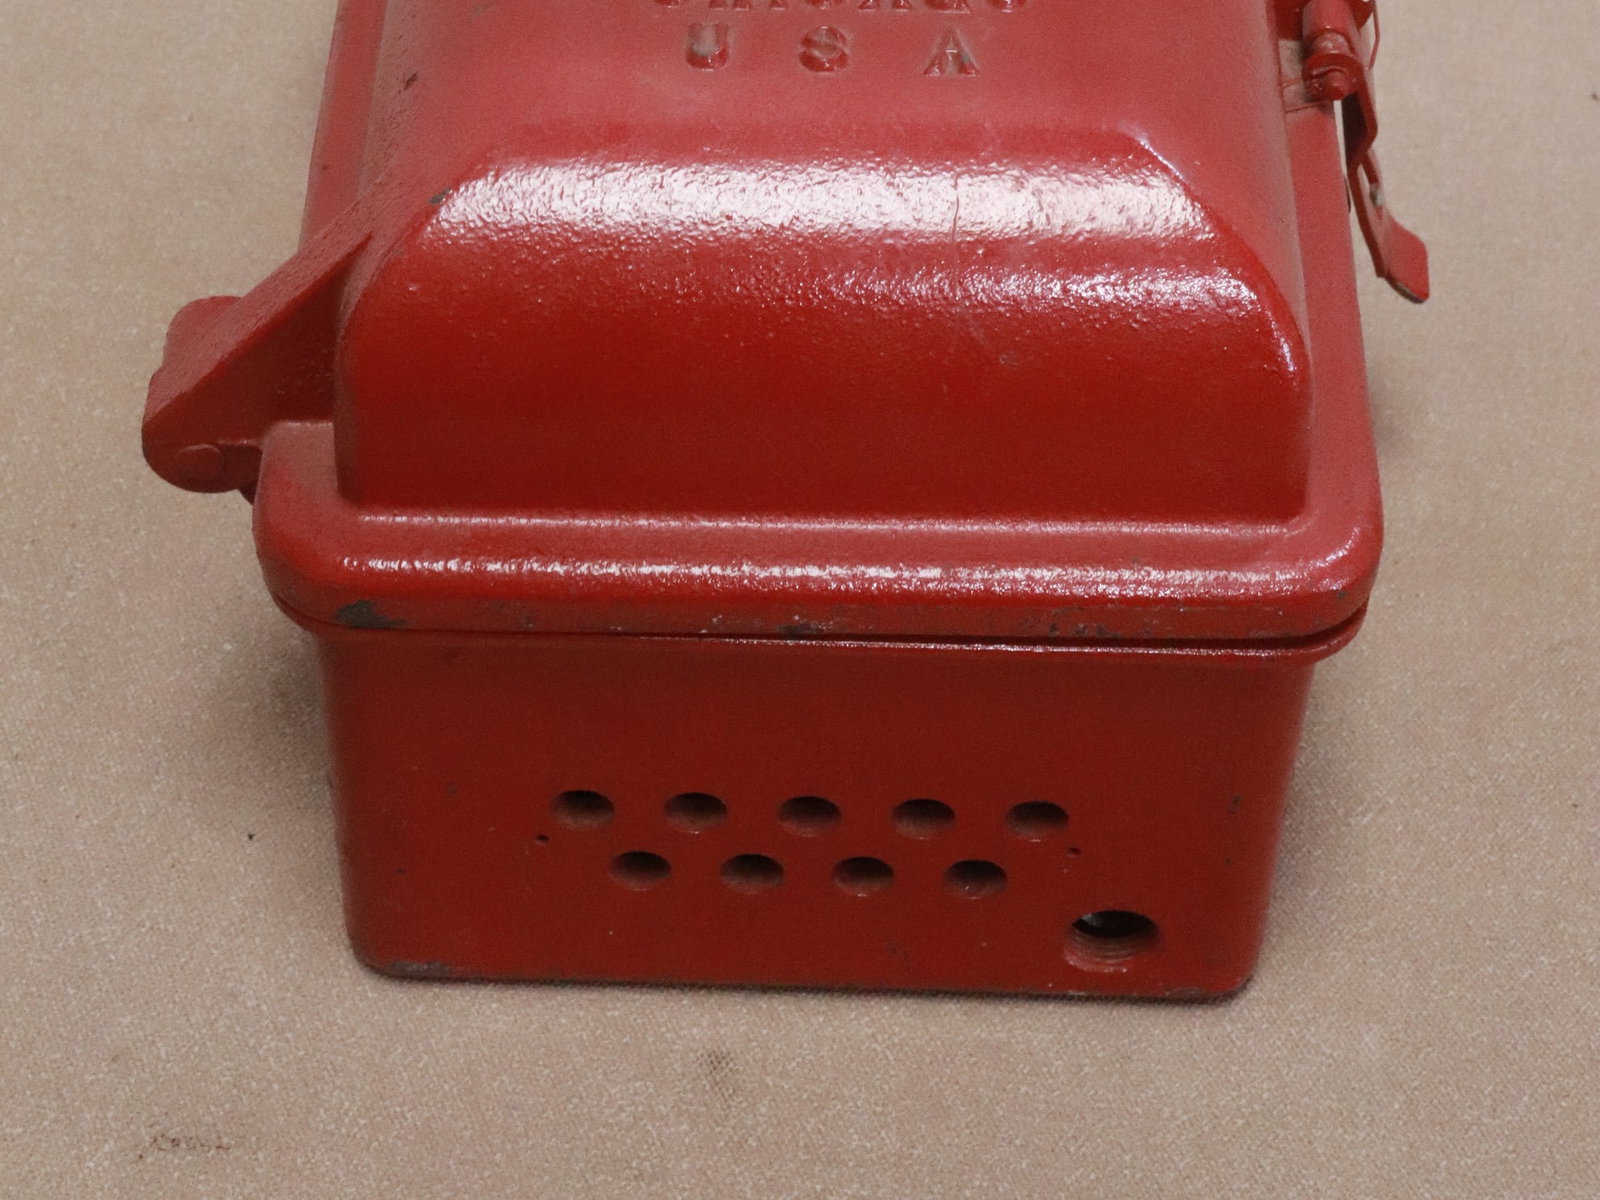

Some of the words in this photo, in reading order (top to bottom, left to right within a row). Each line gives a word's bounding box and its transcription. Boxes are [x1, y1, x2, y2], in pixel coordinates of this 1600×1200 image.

[685, 22, 731, 72] U
[798, 25, 849, 74] S
[922, 28, 981, 77] A
